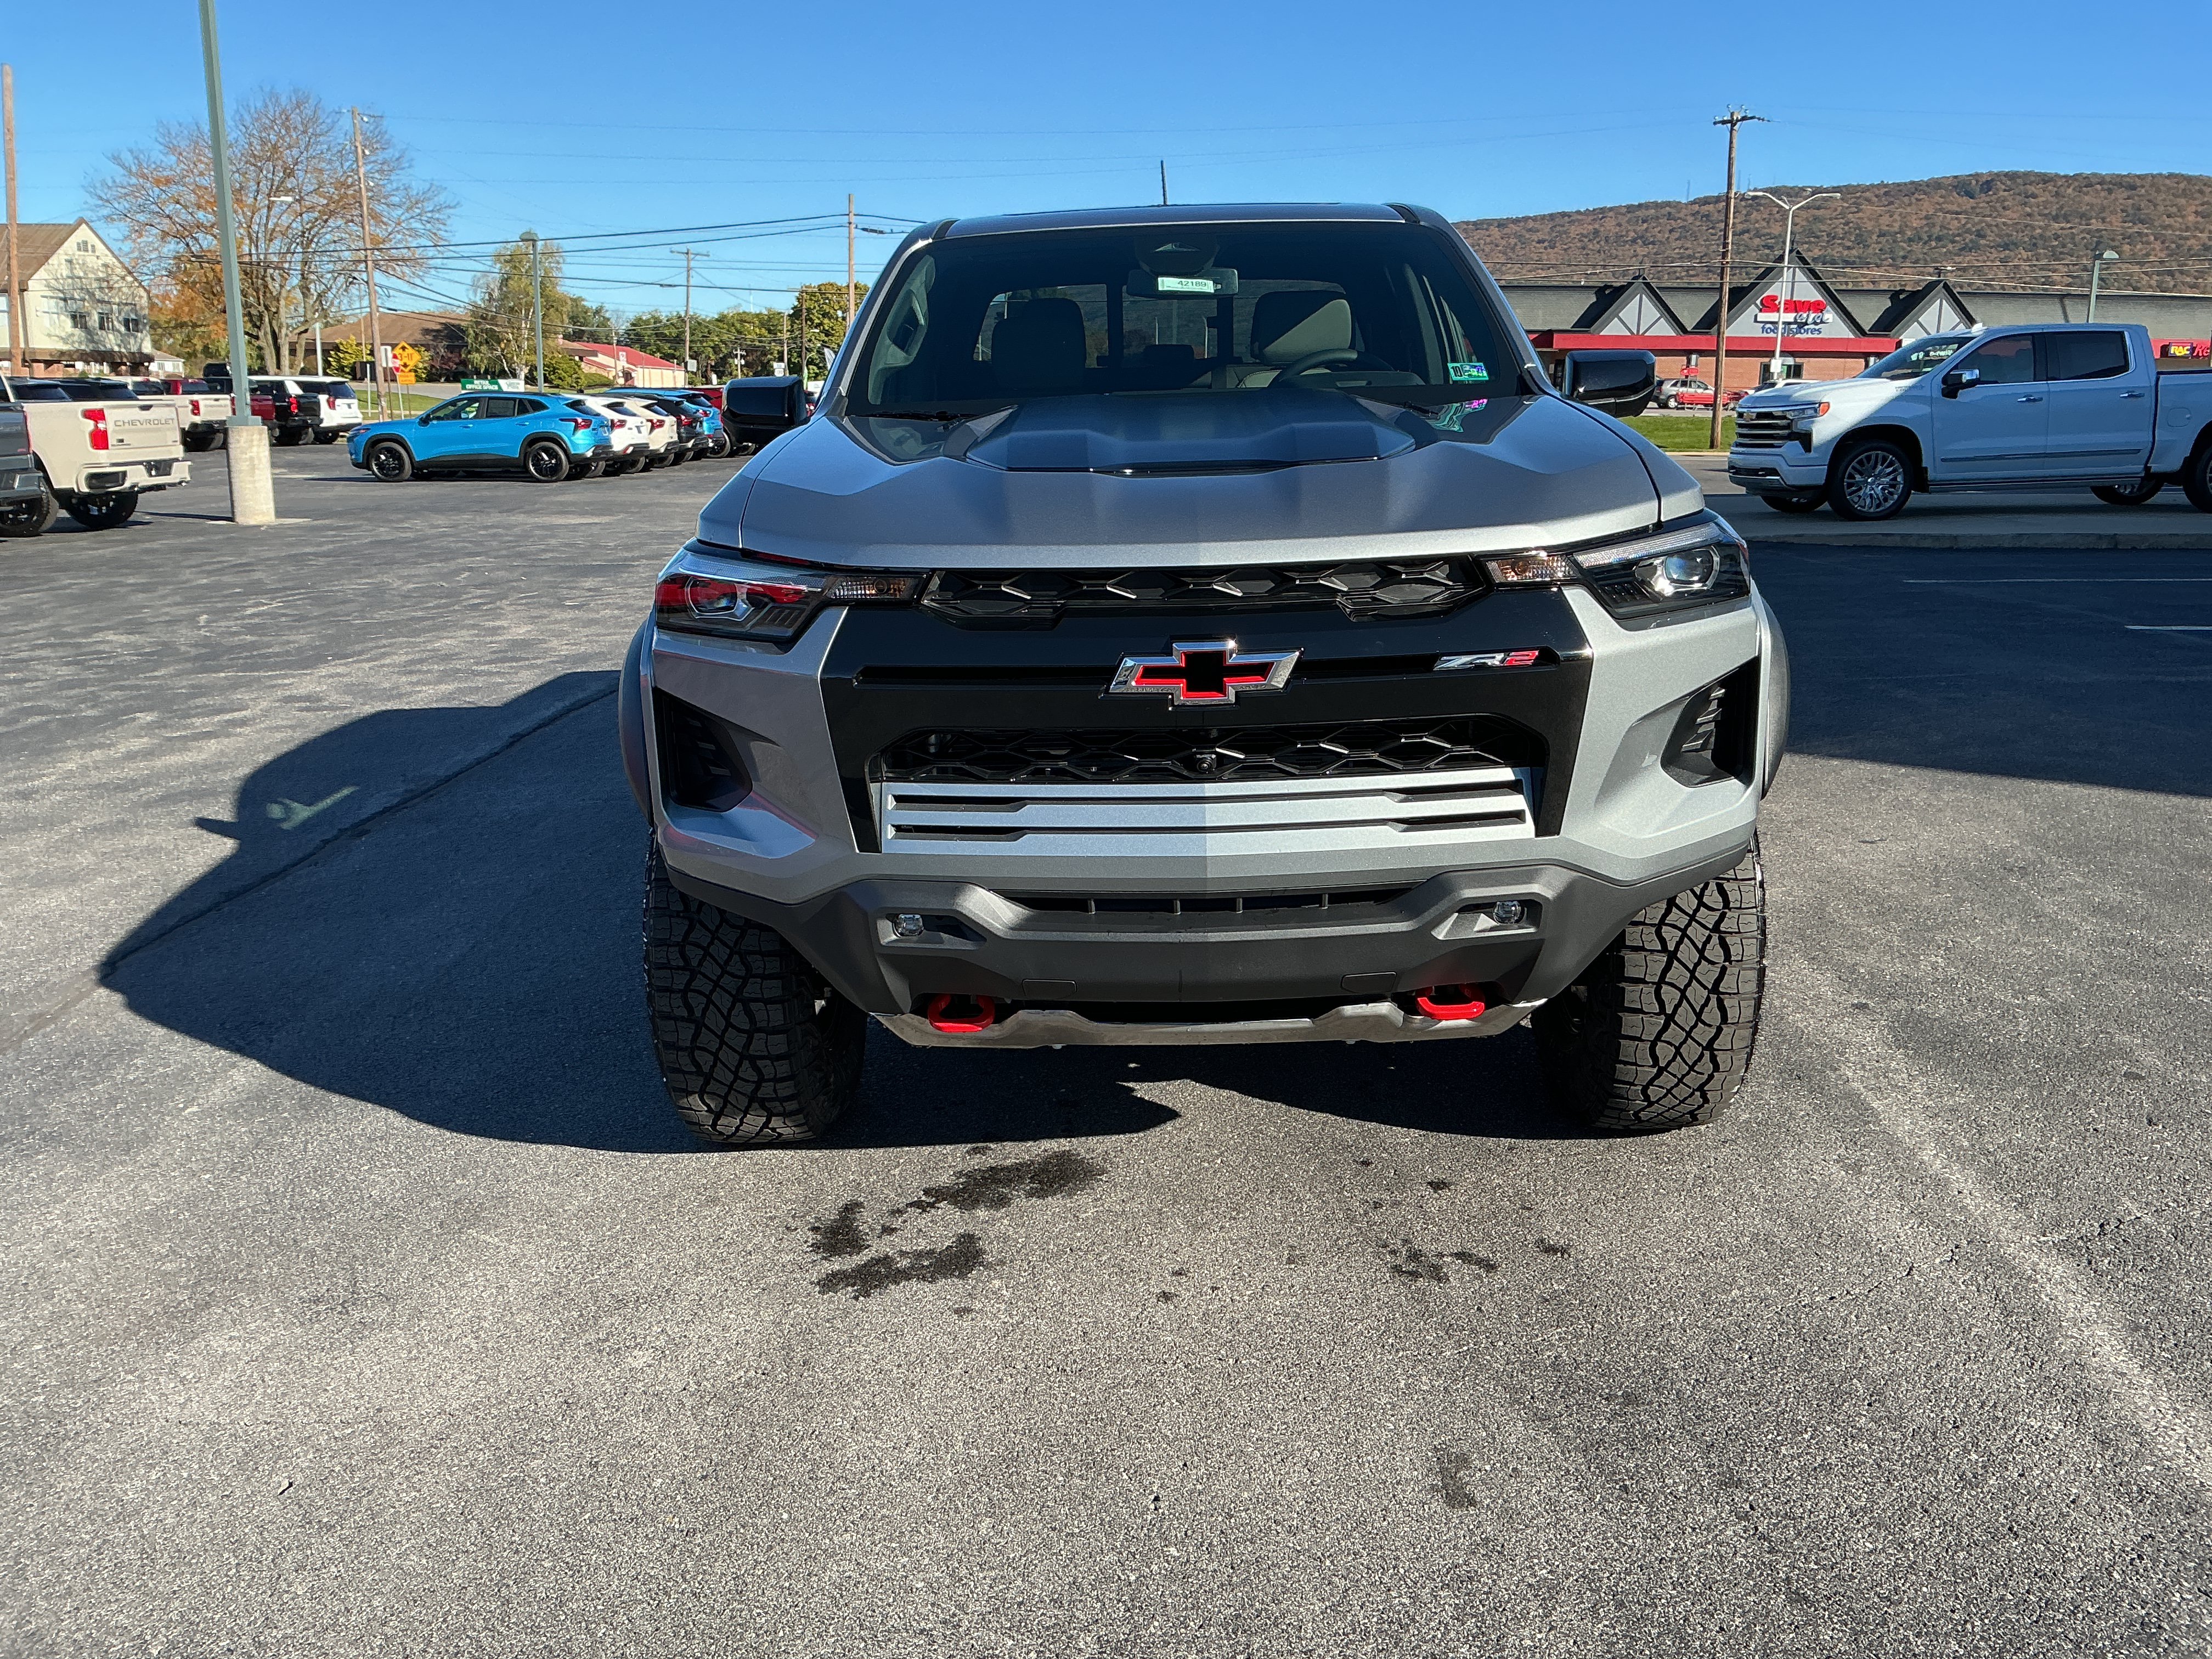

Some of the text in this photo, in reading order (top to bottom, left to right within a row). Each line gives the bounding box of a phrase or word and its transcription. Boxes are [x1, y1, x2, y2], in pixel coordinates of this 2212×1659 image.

[1760, 294, 1826, 314] Save
[1760, 323, 1822, 335] food stores
[2170, 346, 2191, 356] RAC
[114, 417, 174, 427] CHEVROLET
[1432, 650, 1539, 670] ZR2
